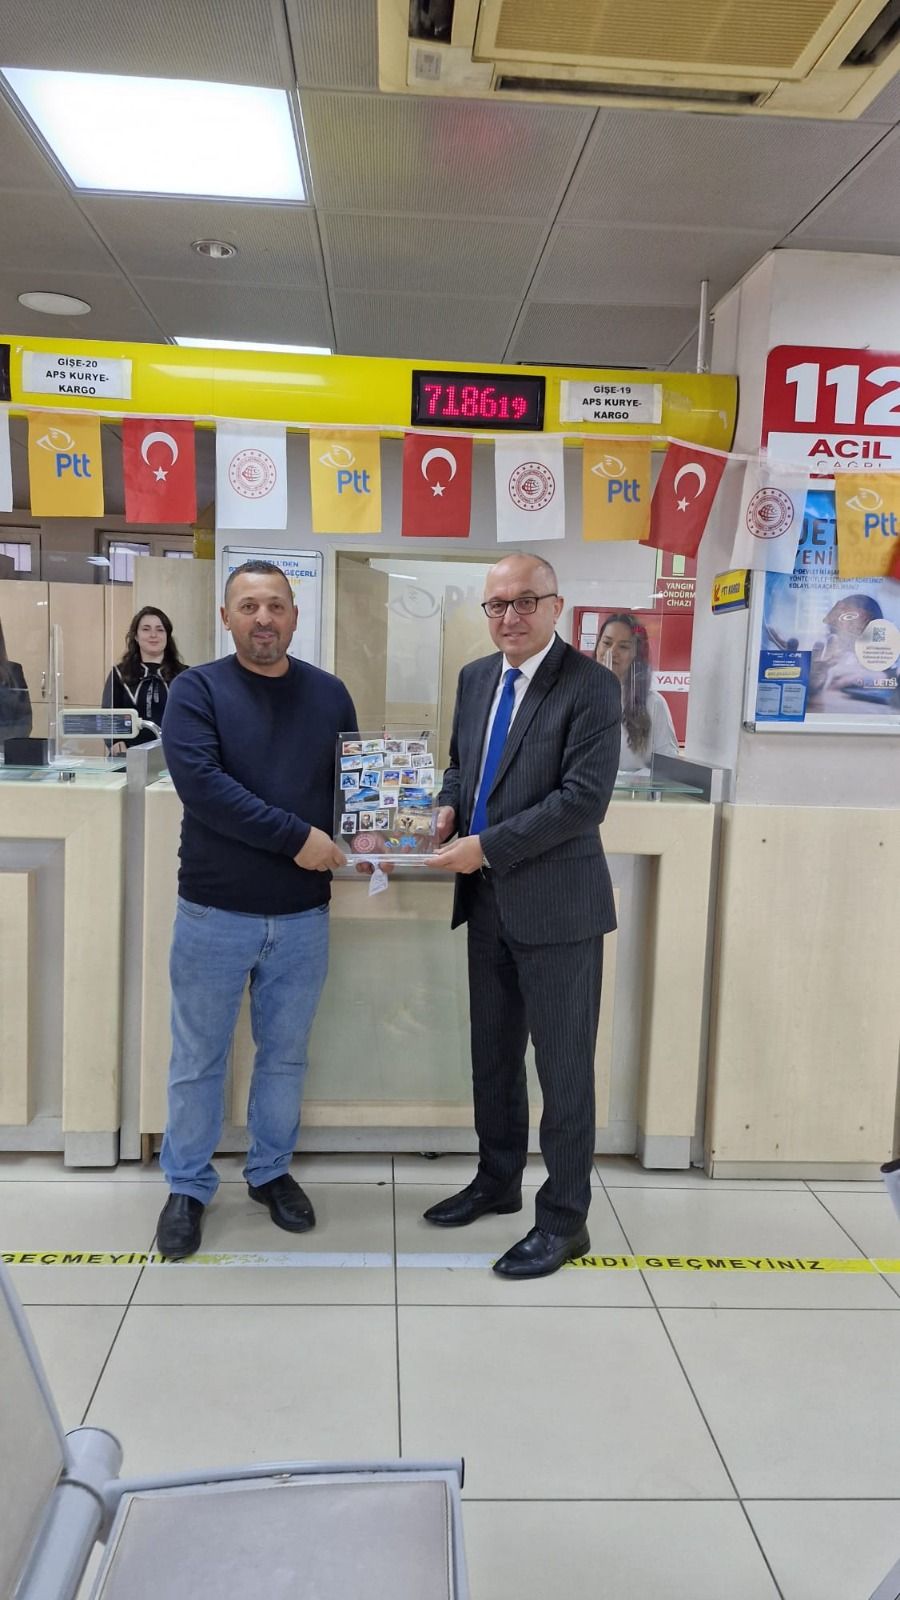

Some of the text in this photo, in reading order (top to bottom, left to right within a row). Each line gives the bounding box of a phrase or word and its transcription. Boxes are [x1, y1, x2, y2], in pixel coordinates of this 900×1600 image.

[58, 357, 98, 369] GİŞE-20
[46, 370, 109, 382] APS KURYE-
[58, 384, 96, 395] KARGO
[593, 385, 631, 395] GİŞE-19
[786, 362, 900, 427] 112
[582, 397, 642, 407] APS KURYE-
[593, 410, 629, 419] KARGO
[56, 453, 92, 478] Ptt
[336, 469, 371, 495] Ptt
[607, 479, 640, 503] Ptt
[864, 511, 899, 537] Ptt
[666, 582, 694, 590] YANGIN
[666, 599, 692, 607] CİHAZI
[645, 1258, 824, 1270] GEÇMEYİNİZ
